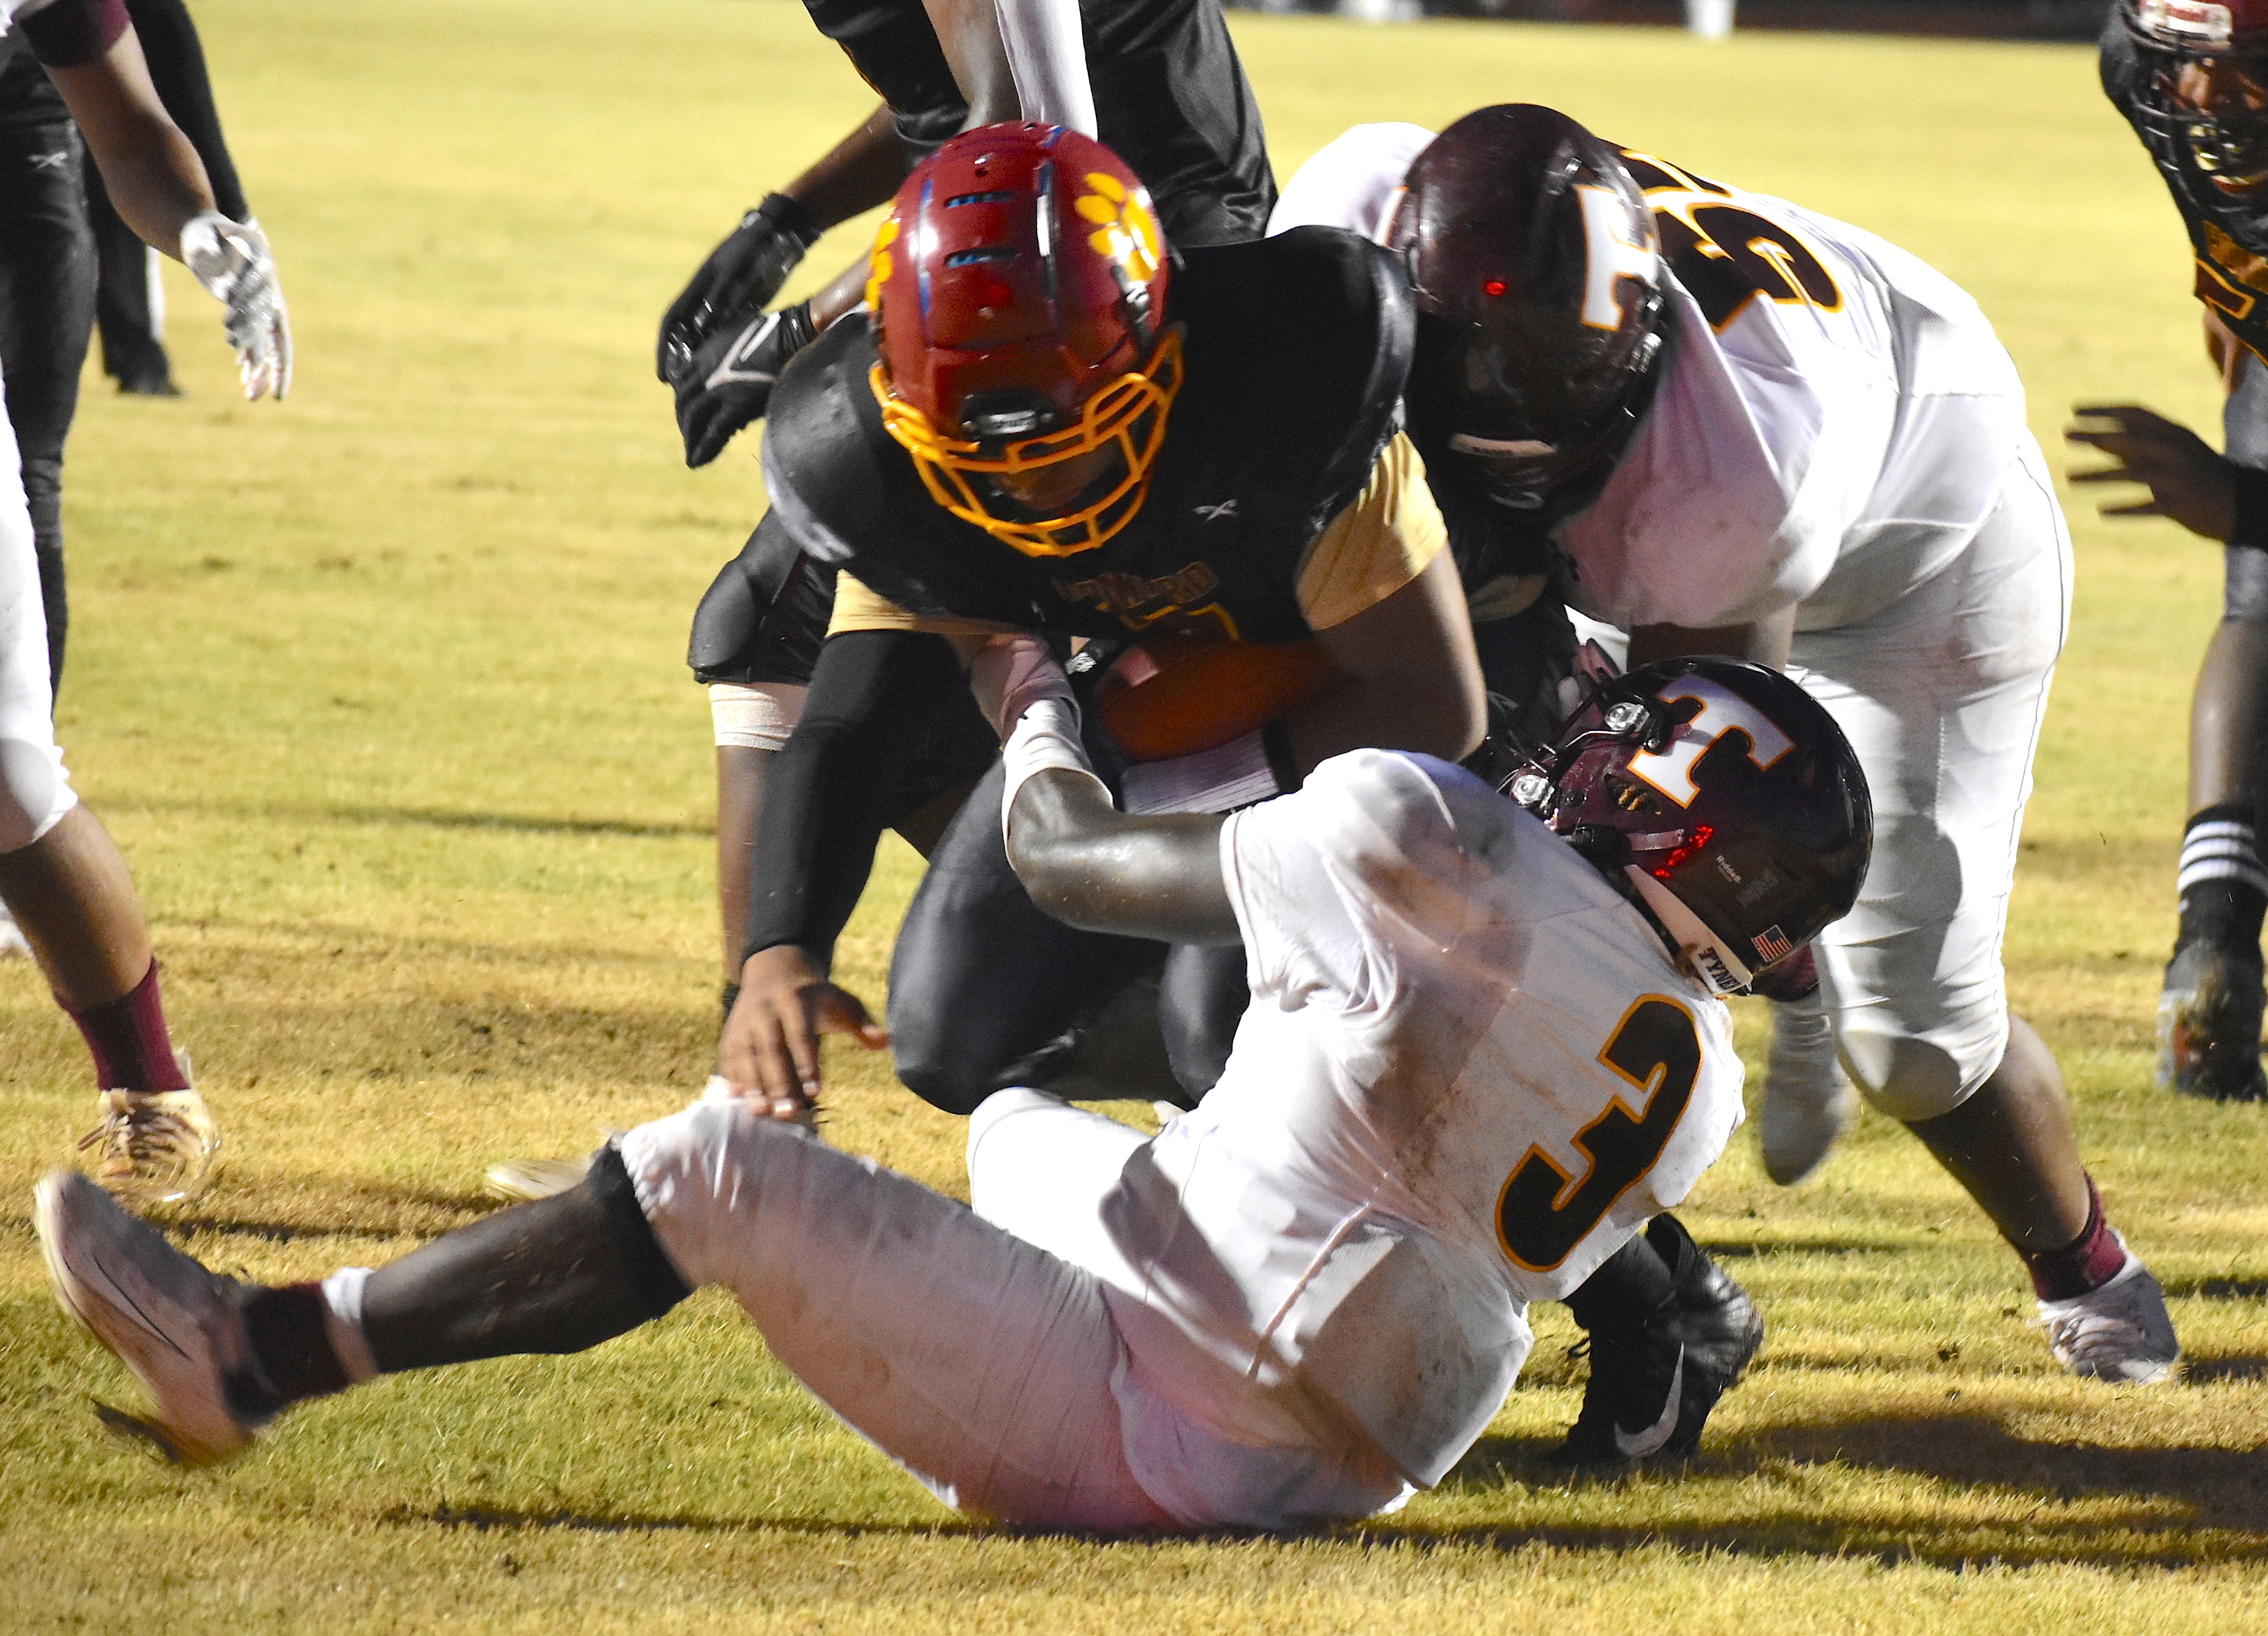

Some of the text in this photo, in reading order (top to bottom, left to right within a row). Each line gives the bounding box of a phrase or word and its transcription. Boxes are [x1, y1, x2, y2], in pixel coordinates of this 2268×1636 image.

[1626, 673, 1796, 809] T
[1698, 947, 1741, 989] TYNE
[1494, 993, 1704, 1273] 3
